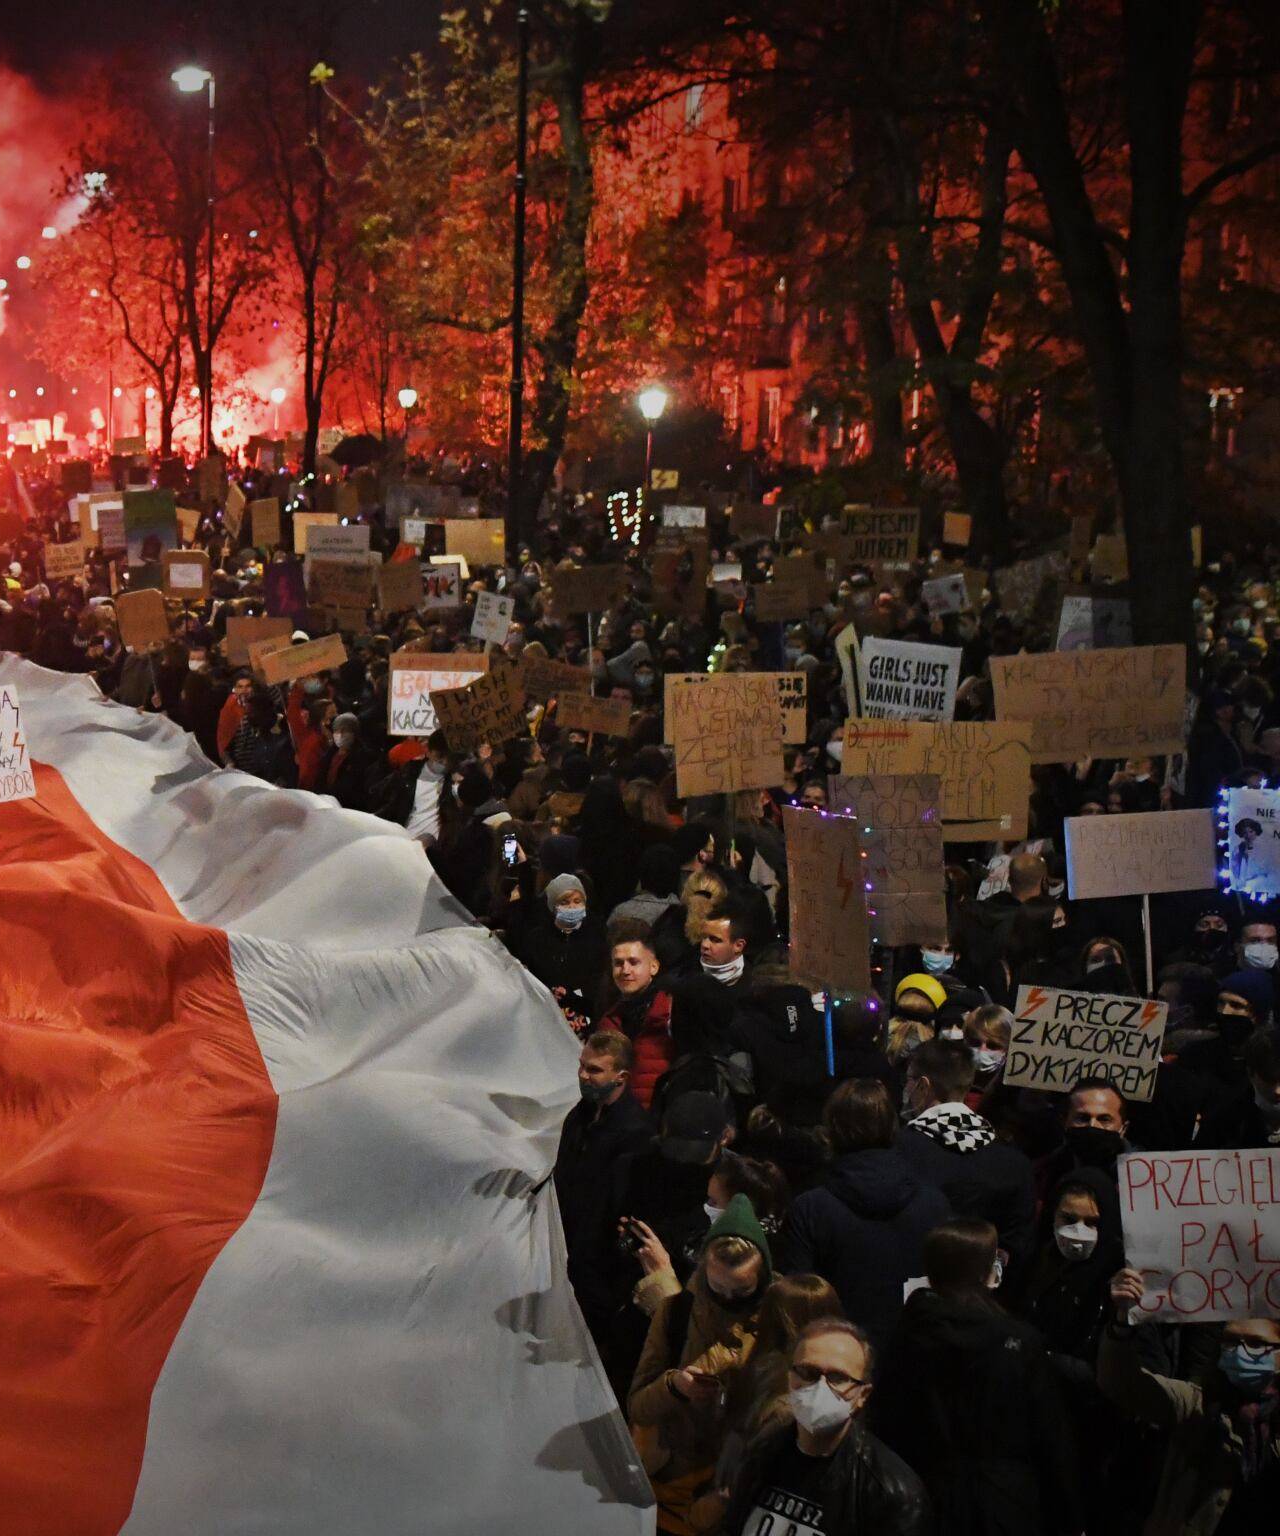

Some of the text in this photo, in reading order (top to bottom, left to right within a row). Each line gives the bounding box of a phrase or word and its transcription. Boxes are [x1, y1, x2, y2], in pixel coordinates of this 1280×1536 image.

[870, 656, 949, 688] GIRLS JUST
[865, 683, 946, 712] WANNA HAVE
[1257, 808, 1276, 818] NIE
[1054, 994, 1142, 1029] PRECZ
[1012, 1018, 1161, 1060] Z KACZOREM
[1007, 1051, 1157, 1102] DYKTATOREM
